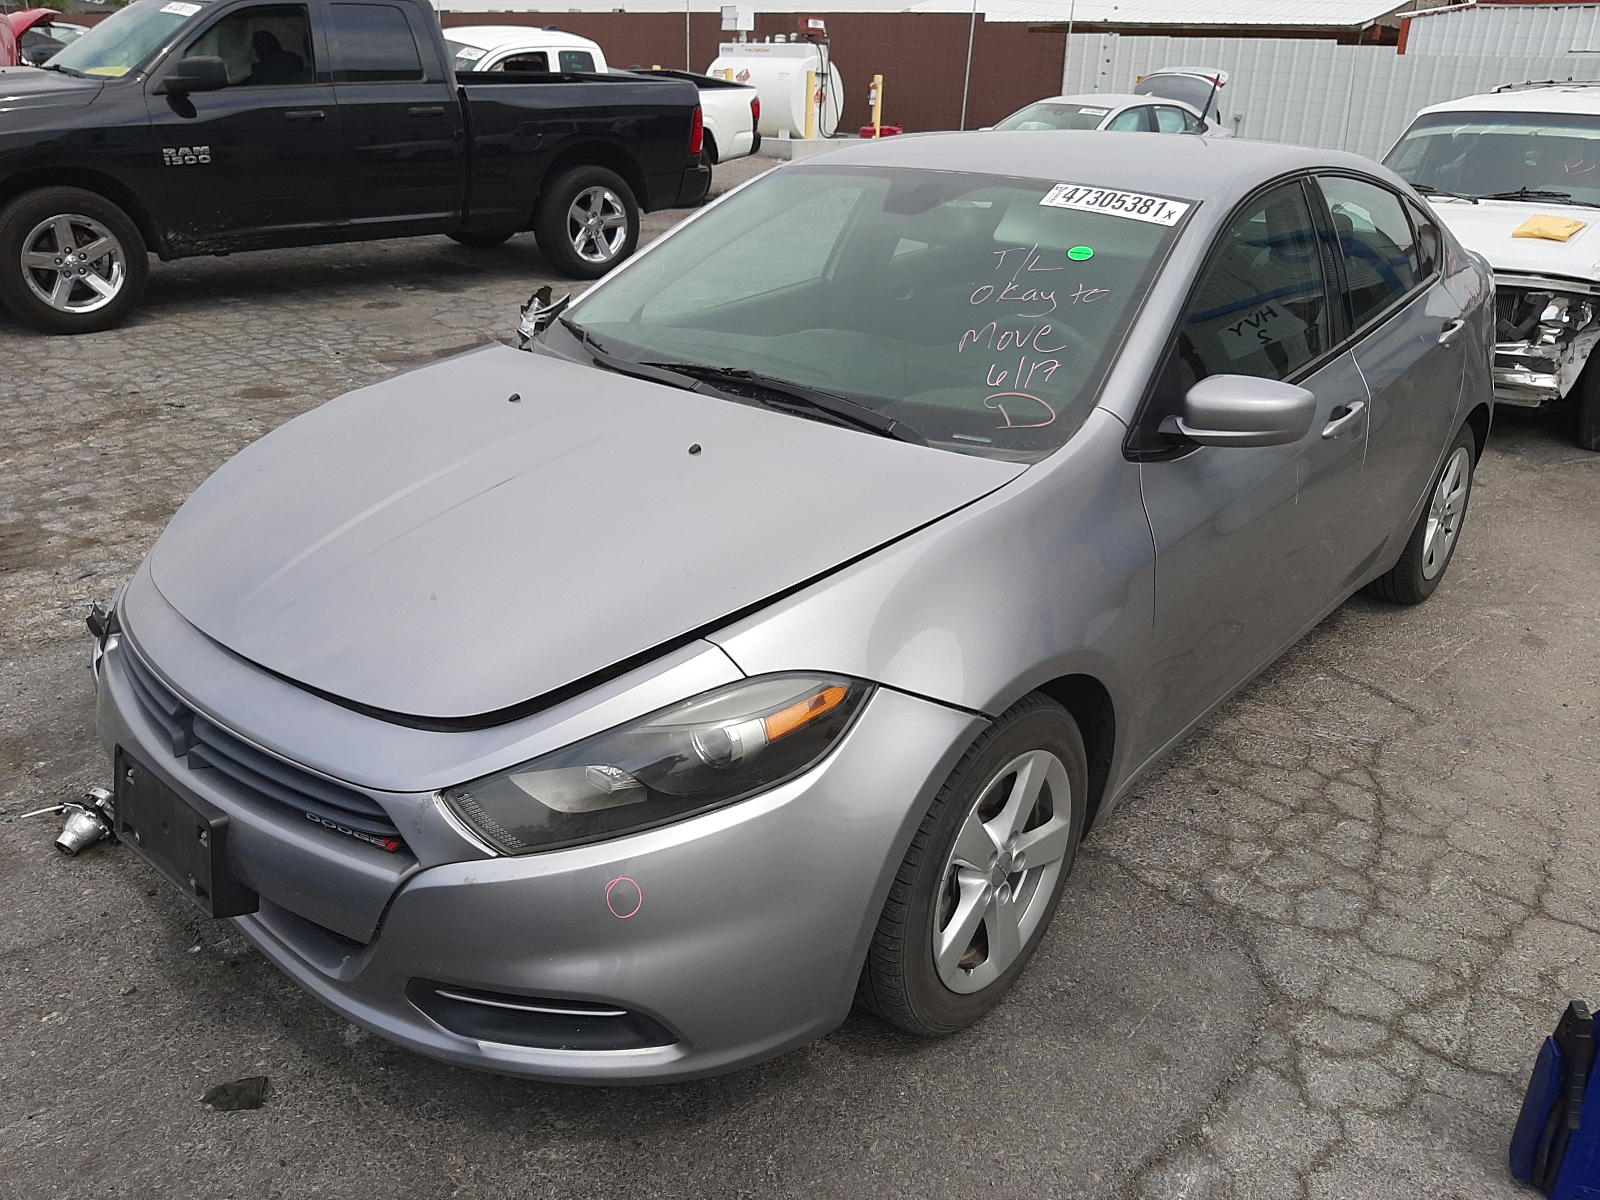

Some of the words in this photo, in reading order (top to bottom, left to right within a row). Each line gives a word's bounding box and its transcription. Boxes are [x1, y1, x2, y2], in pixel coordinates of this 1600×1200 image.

[163, 146, 210, 156] RAM
[164, 155, 211, 166] 1500
[1062, 187, 1168, 217] 47305381
[305, 811, 386, 847] DODGE
